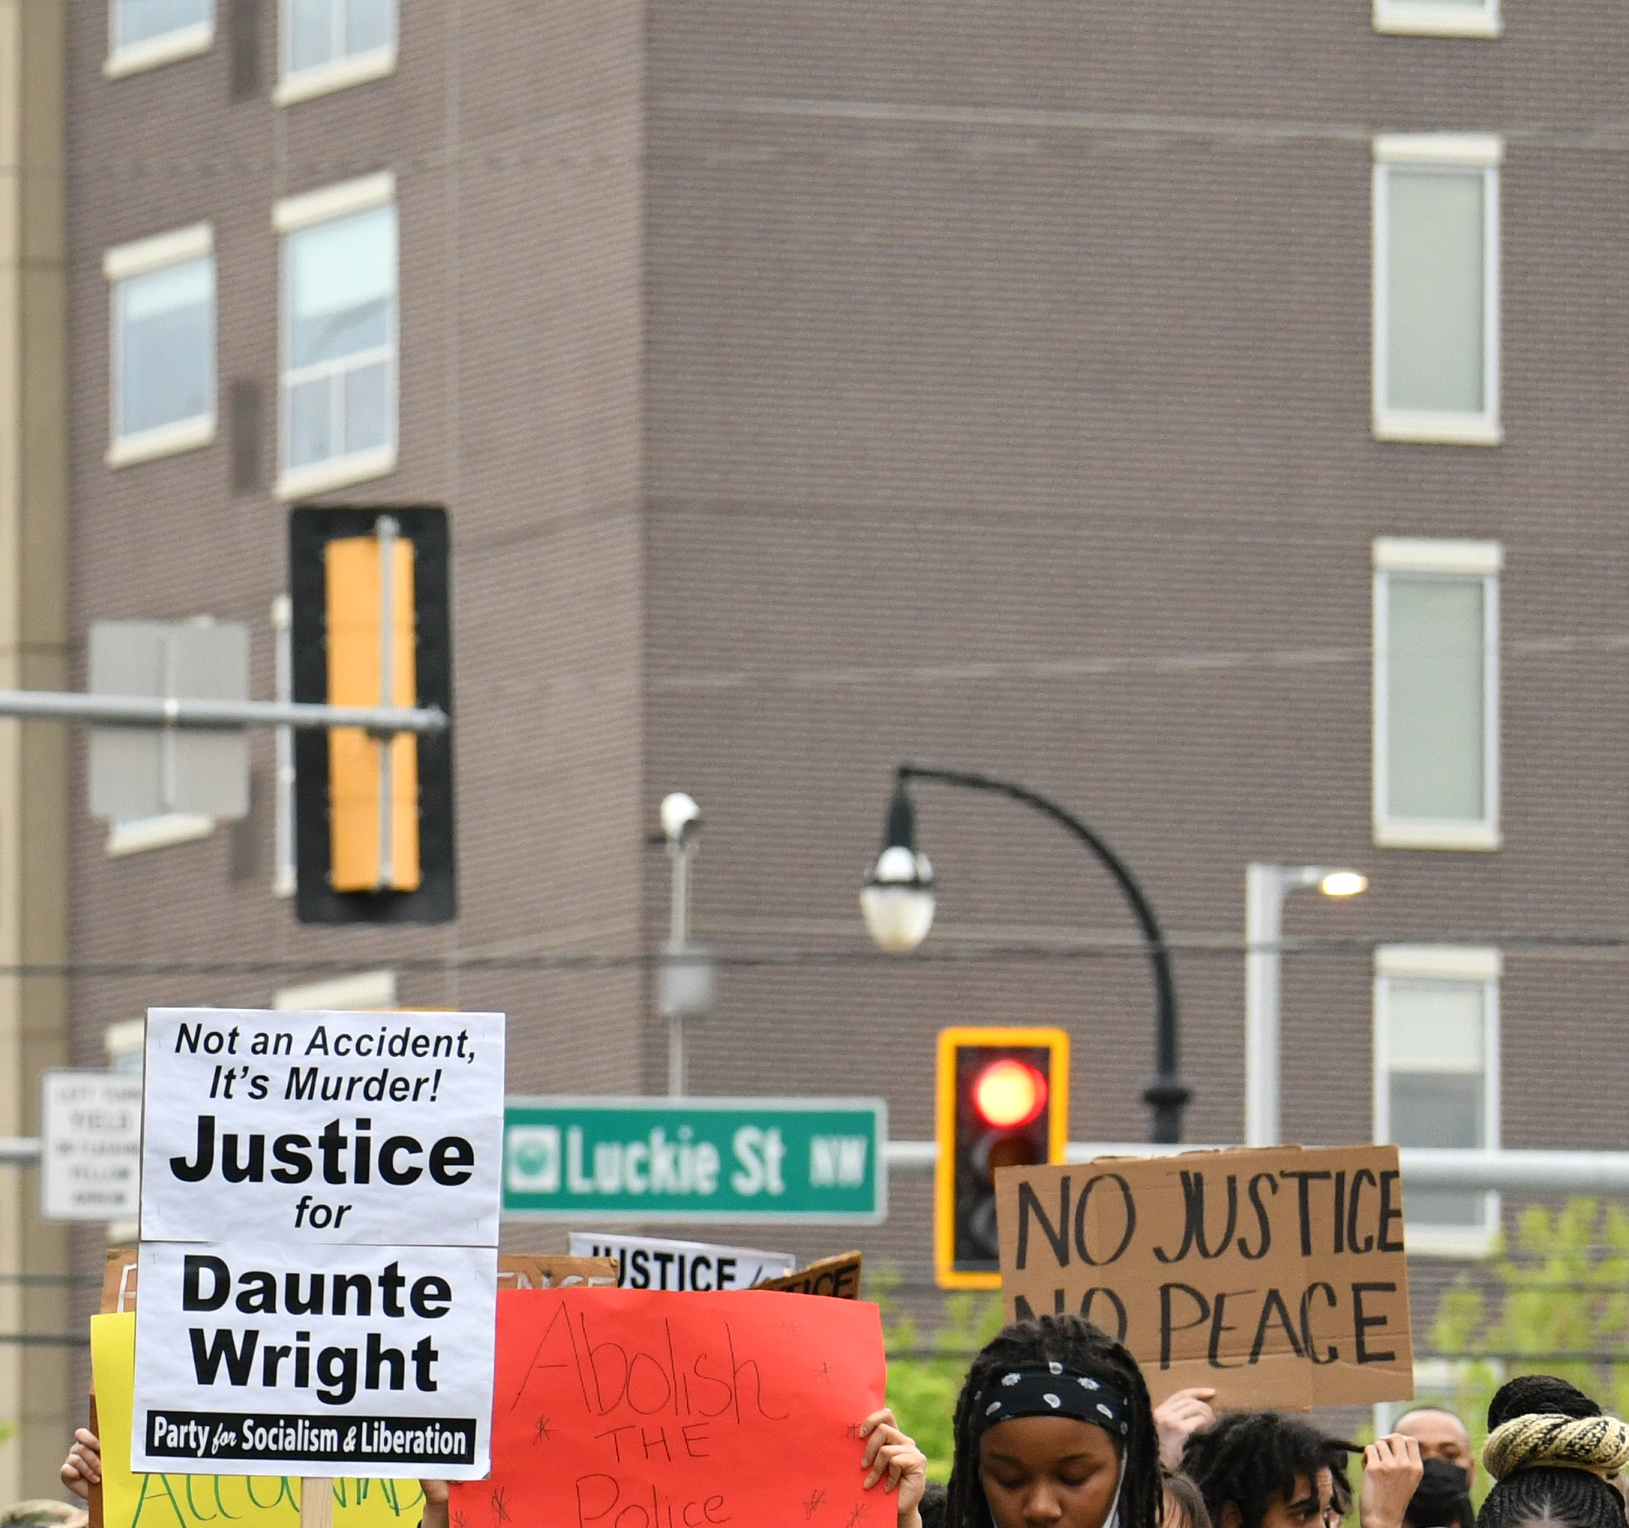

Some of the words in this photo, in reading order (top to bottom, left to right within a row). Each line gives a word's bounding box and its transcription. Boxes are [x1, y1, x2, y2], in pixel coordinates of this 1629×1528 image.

[175, 1022, 239, 1057] Not
[251, 1030, 293, 1057] an
[304, 1025, 477, 1064] Accident,
[209, 1064, 270, 1101] It's
[284, 1066, 442, 1103] Murder!
[169, 1114, 475, 1186] Justice
[567, 1126, 719, 1197] Luckie
[732, 1126, 786, 1196] St
[809, 1135, 867, 1189] NW
[293, 1195, 352, 1229] for
[1015, 1172, 1136, 1270] NO
[1153, 1167, 1403, 1264] JUSTICE
[183, 1254, 452, 1319] Daunte
[1159, 1282, 1397, 1371] PEACE
[189, 1327, 438, 1406] Wright
[510, 1301, 789, 1424] Abolish
[153, 1415, 210, 1458] Party
[211, 1421, 238, 1453] for
[241, 1417, 339, 1453] Socialism
[343, 1425, 357, 1453] &
[360, 1421, 467, 1456] Liberation
[594, 1422, 711, 1463] THE
